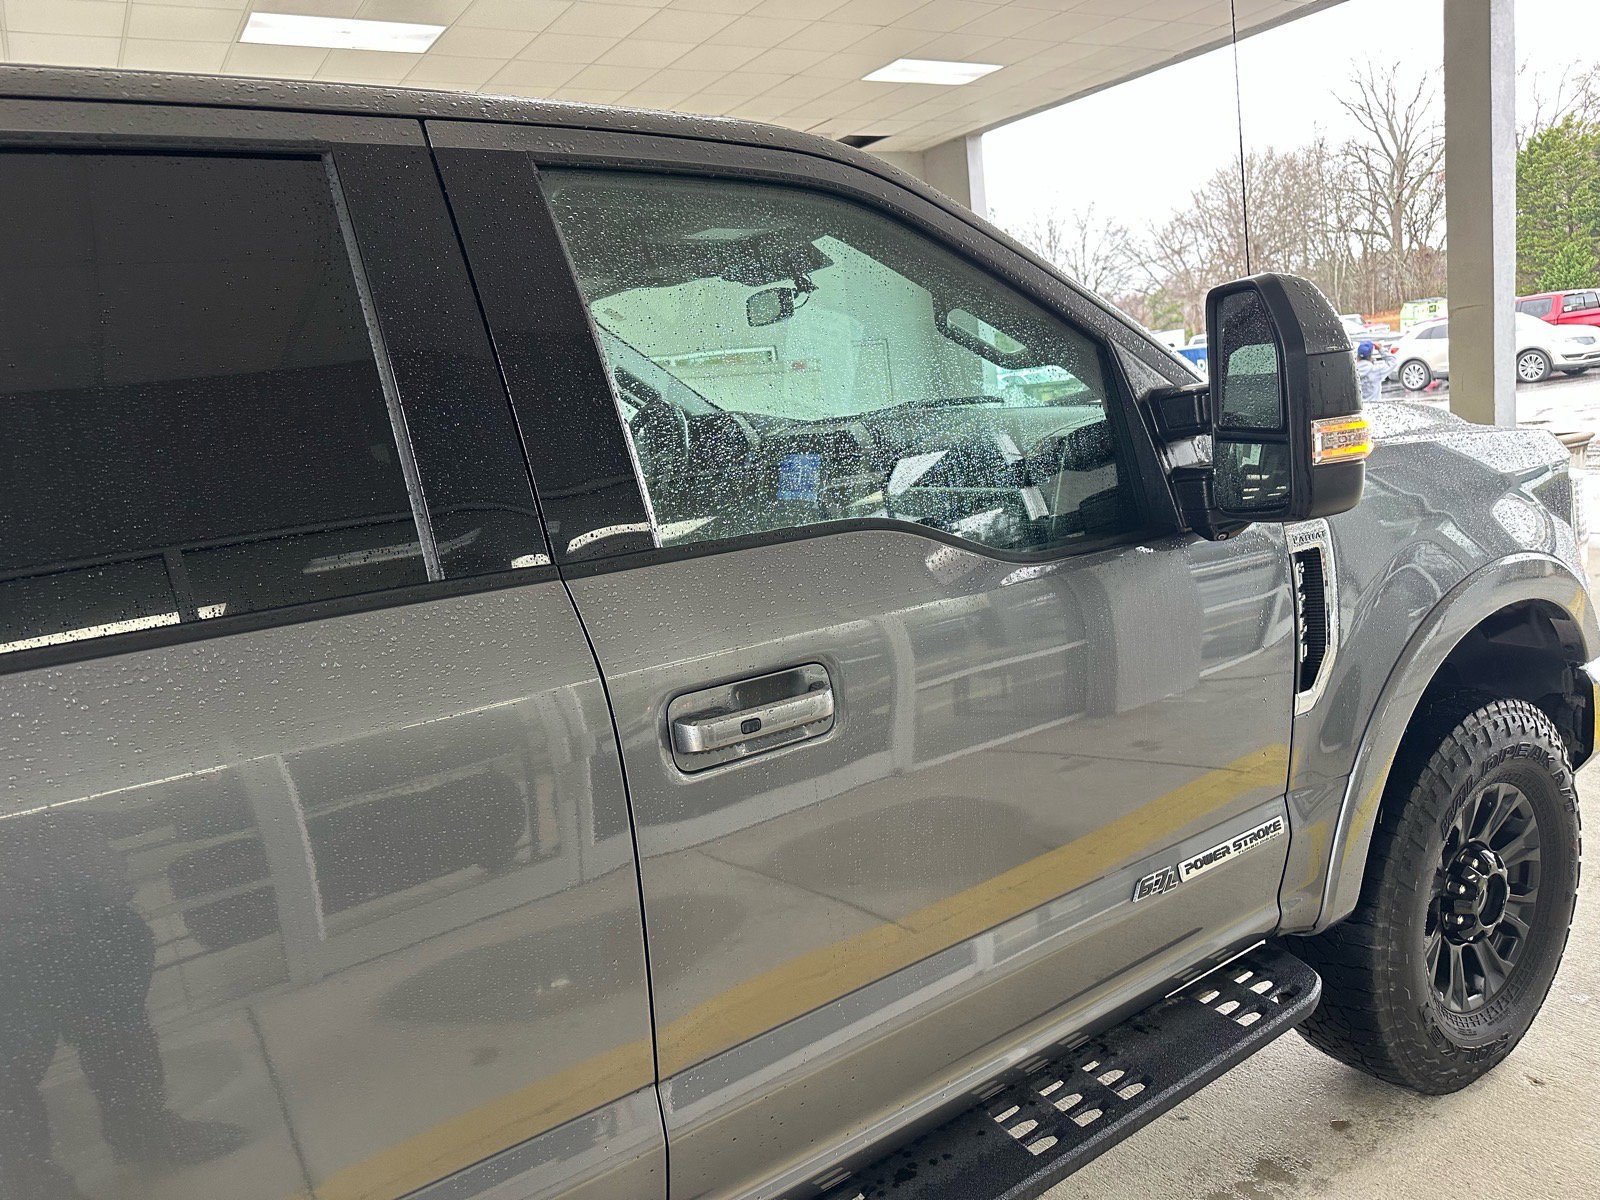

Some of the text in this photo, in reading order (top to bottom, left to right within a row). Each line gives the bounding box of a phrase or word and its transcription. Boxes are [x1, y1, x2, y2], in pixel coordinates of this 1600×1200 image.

[1291, 529, 1326, 545] LARIAT
[1441, 741, 1577, 842] WILDPEAK A/T
[1133, 819, 1282, 903] 6.7L POWER STROKE
